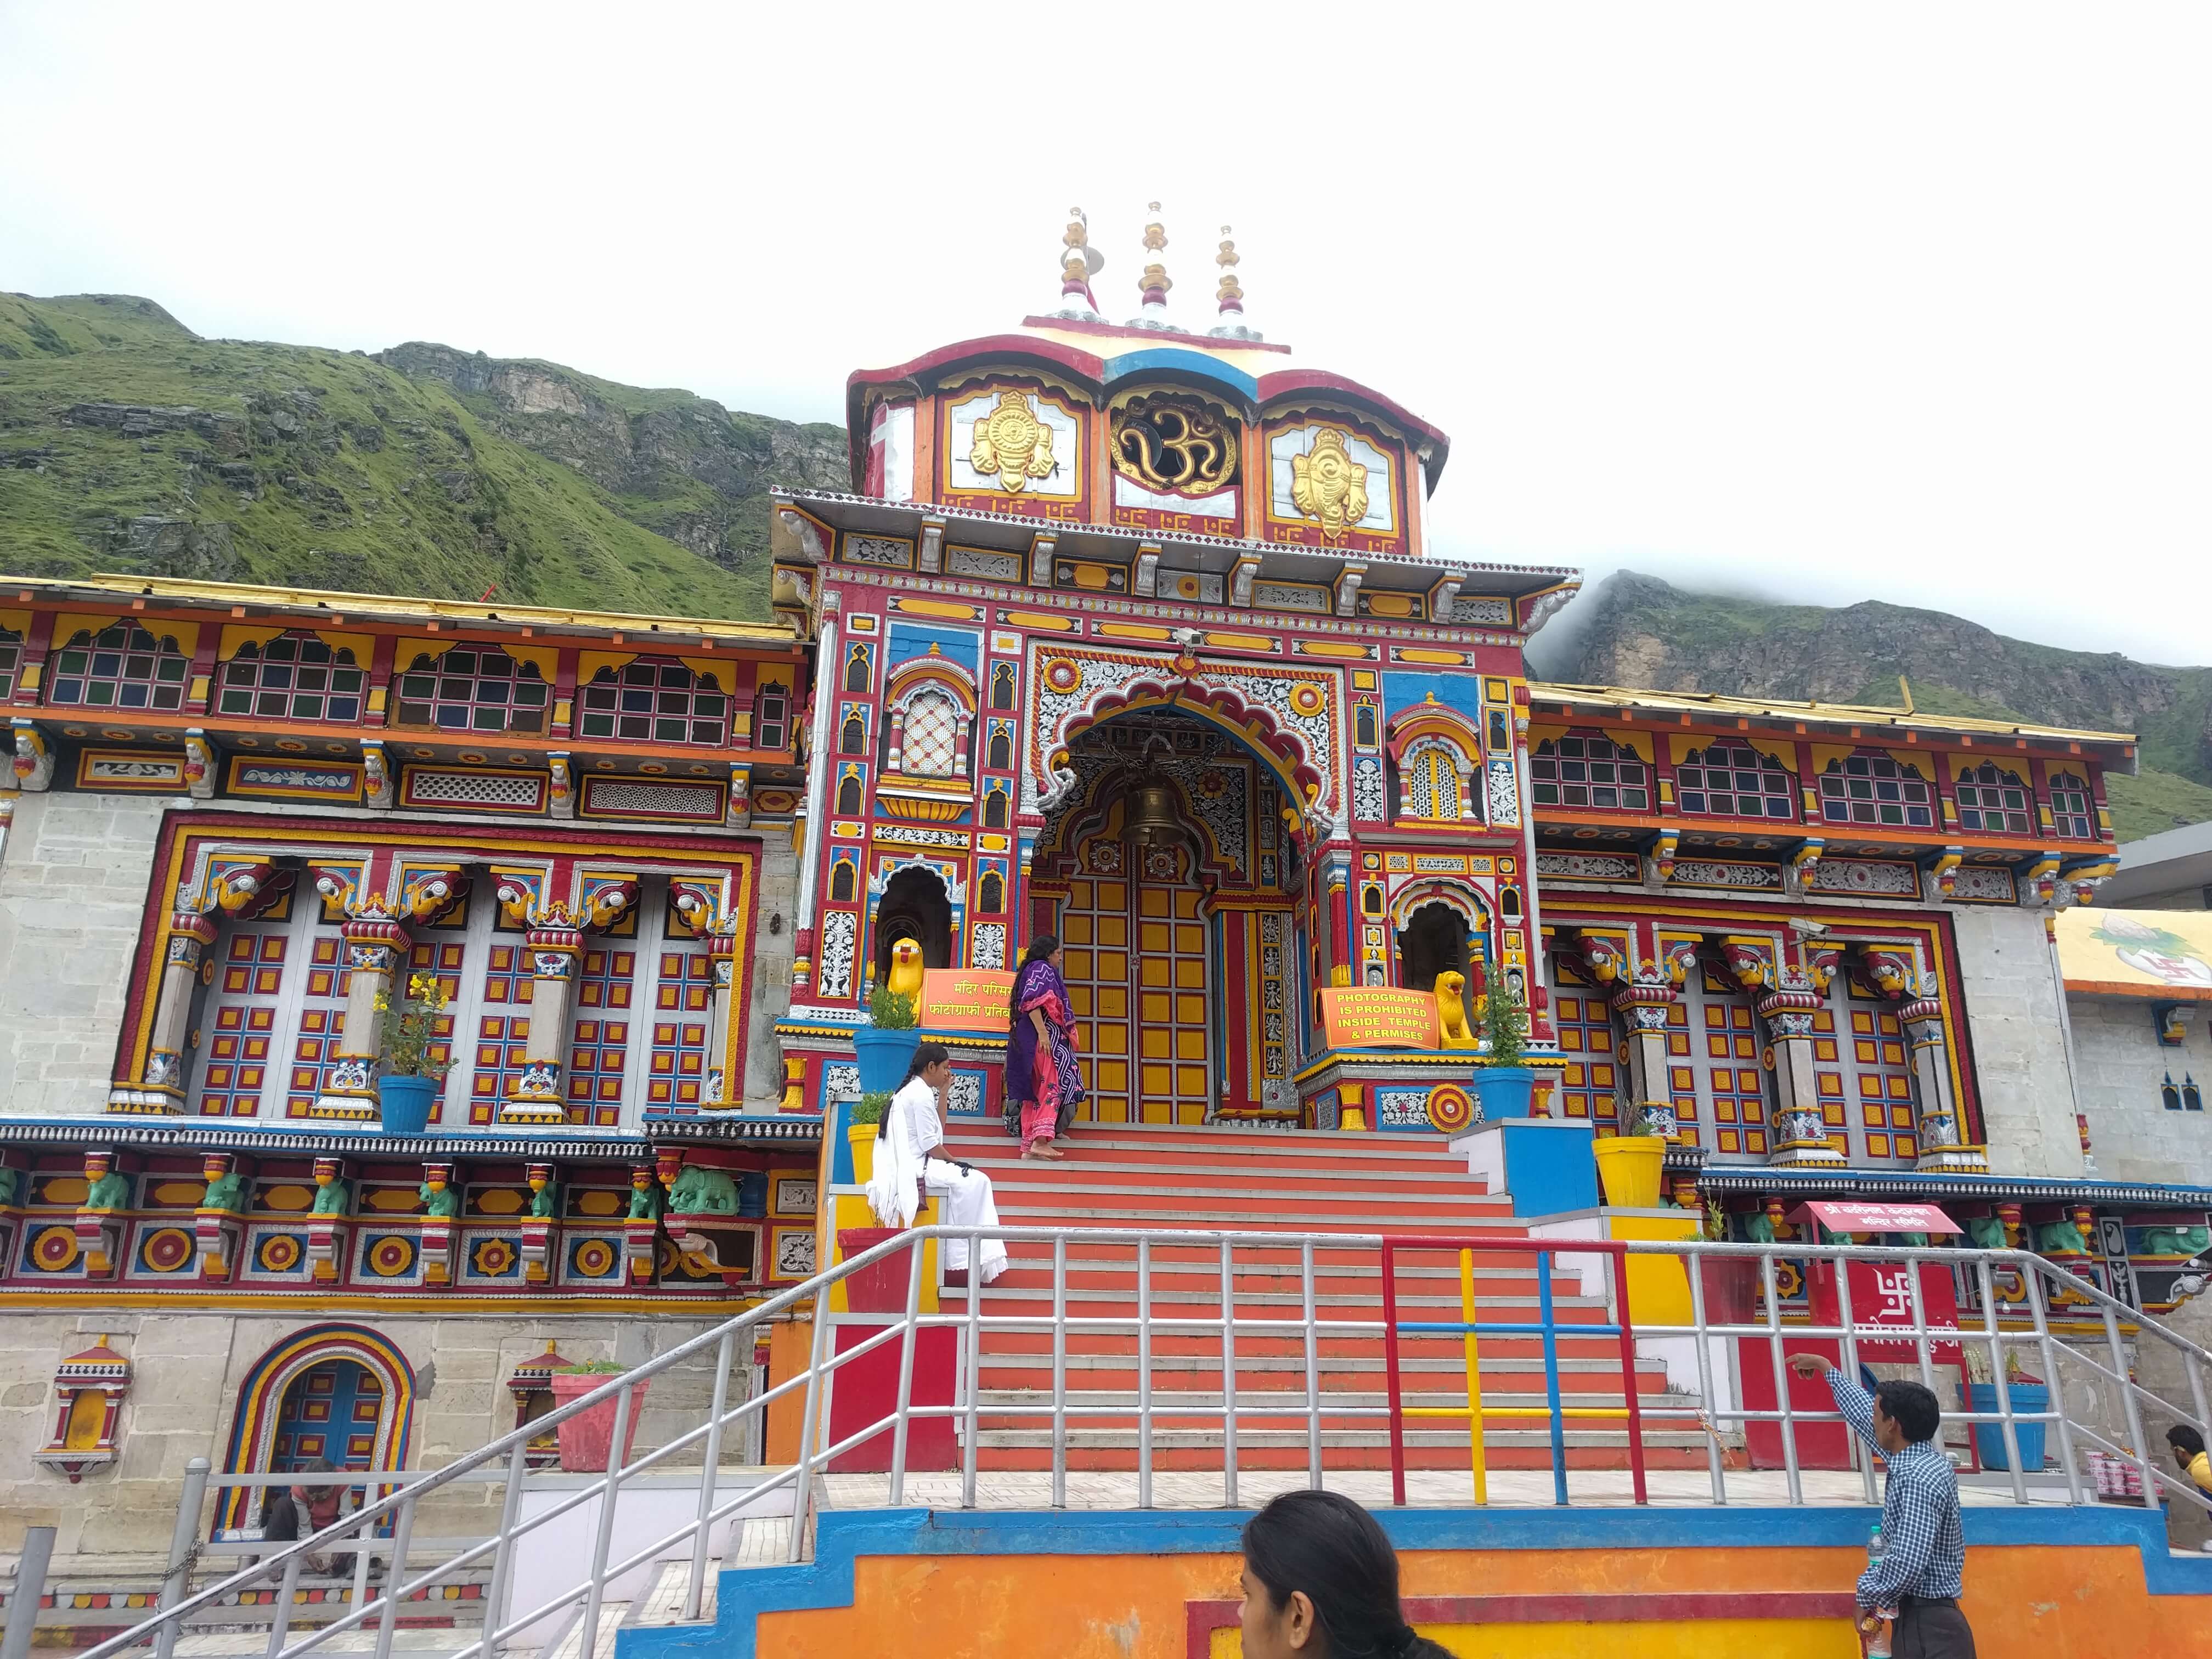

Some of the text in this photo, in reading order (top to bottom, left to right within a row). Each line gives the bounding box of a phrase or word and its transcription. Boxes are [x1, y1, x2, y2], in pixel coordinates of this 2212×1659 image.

[953, 979, 979, 996] मंदिर
[1337, 994, 1425, 1006] PHOTOGRAPHY
[928, 1000, 1011, 1019] फोटोग्राफी प्रतिब
[1340, 1006, 1427, 1017] IS PROHIBITED
[1338, 1017, 1431, 1030] INSIDE TEMPLE
[1351, 1029, 1423, 1041] & PERMISES
[1824, 1204, 1841, 1214] श्री
